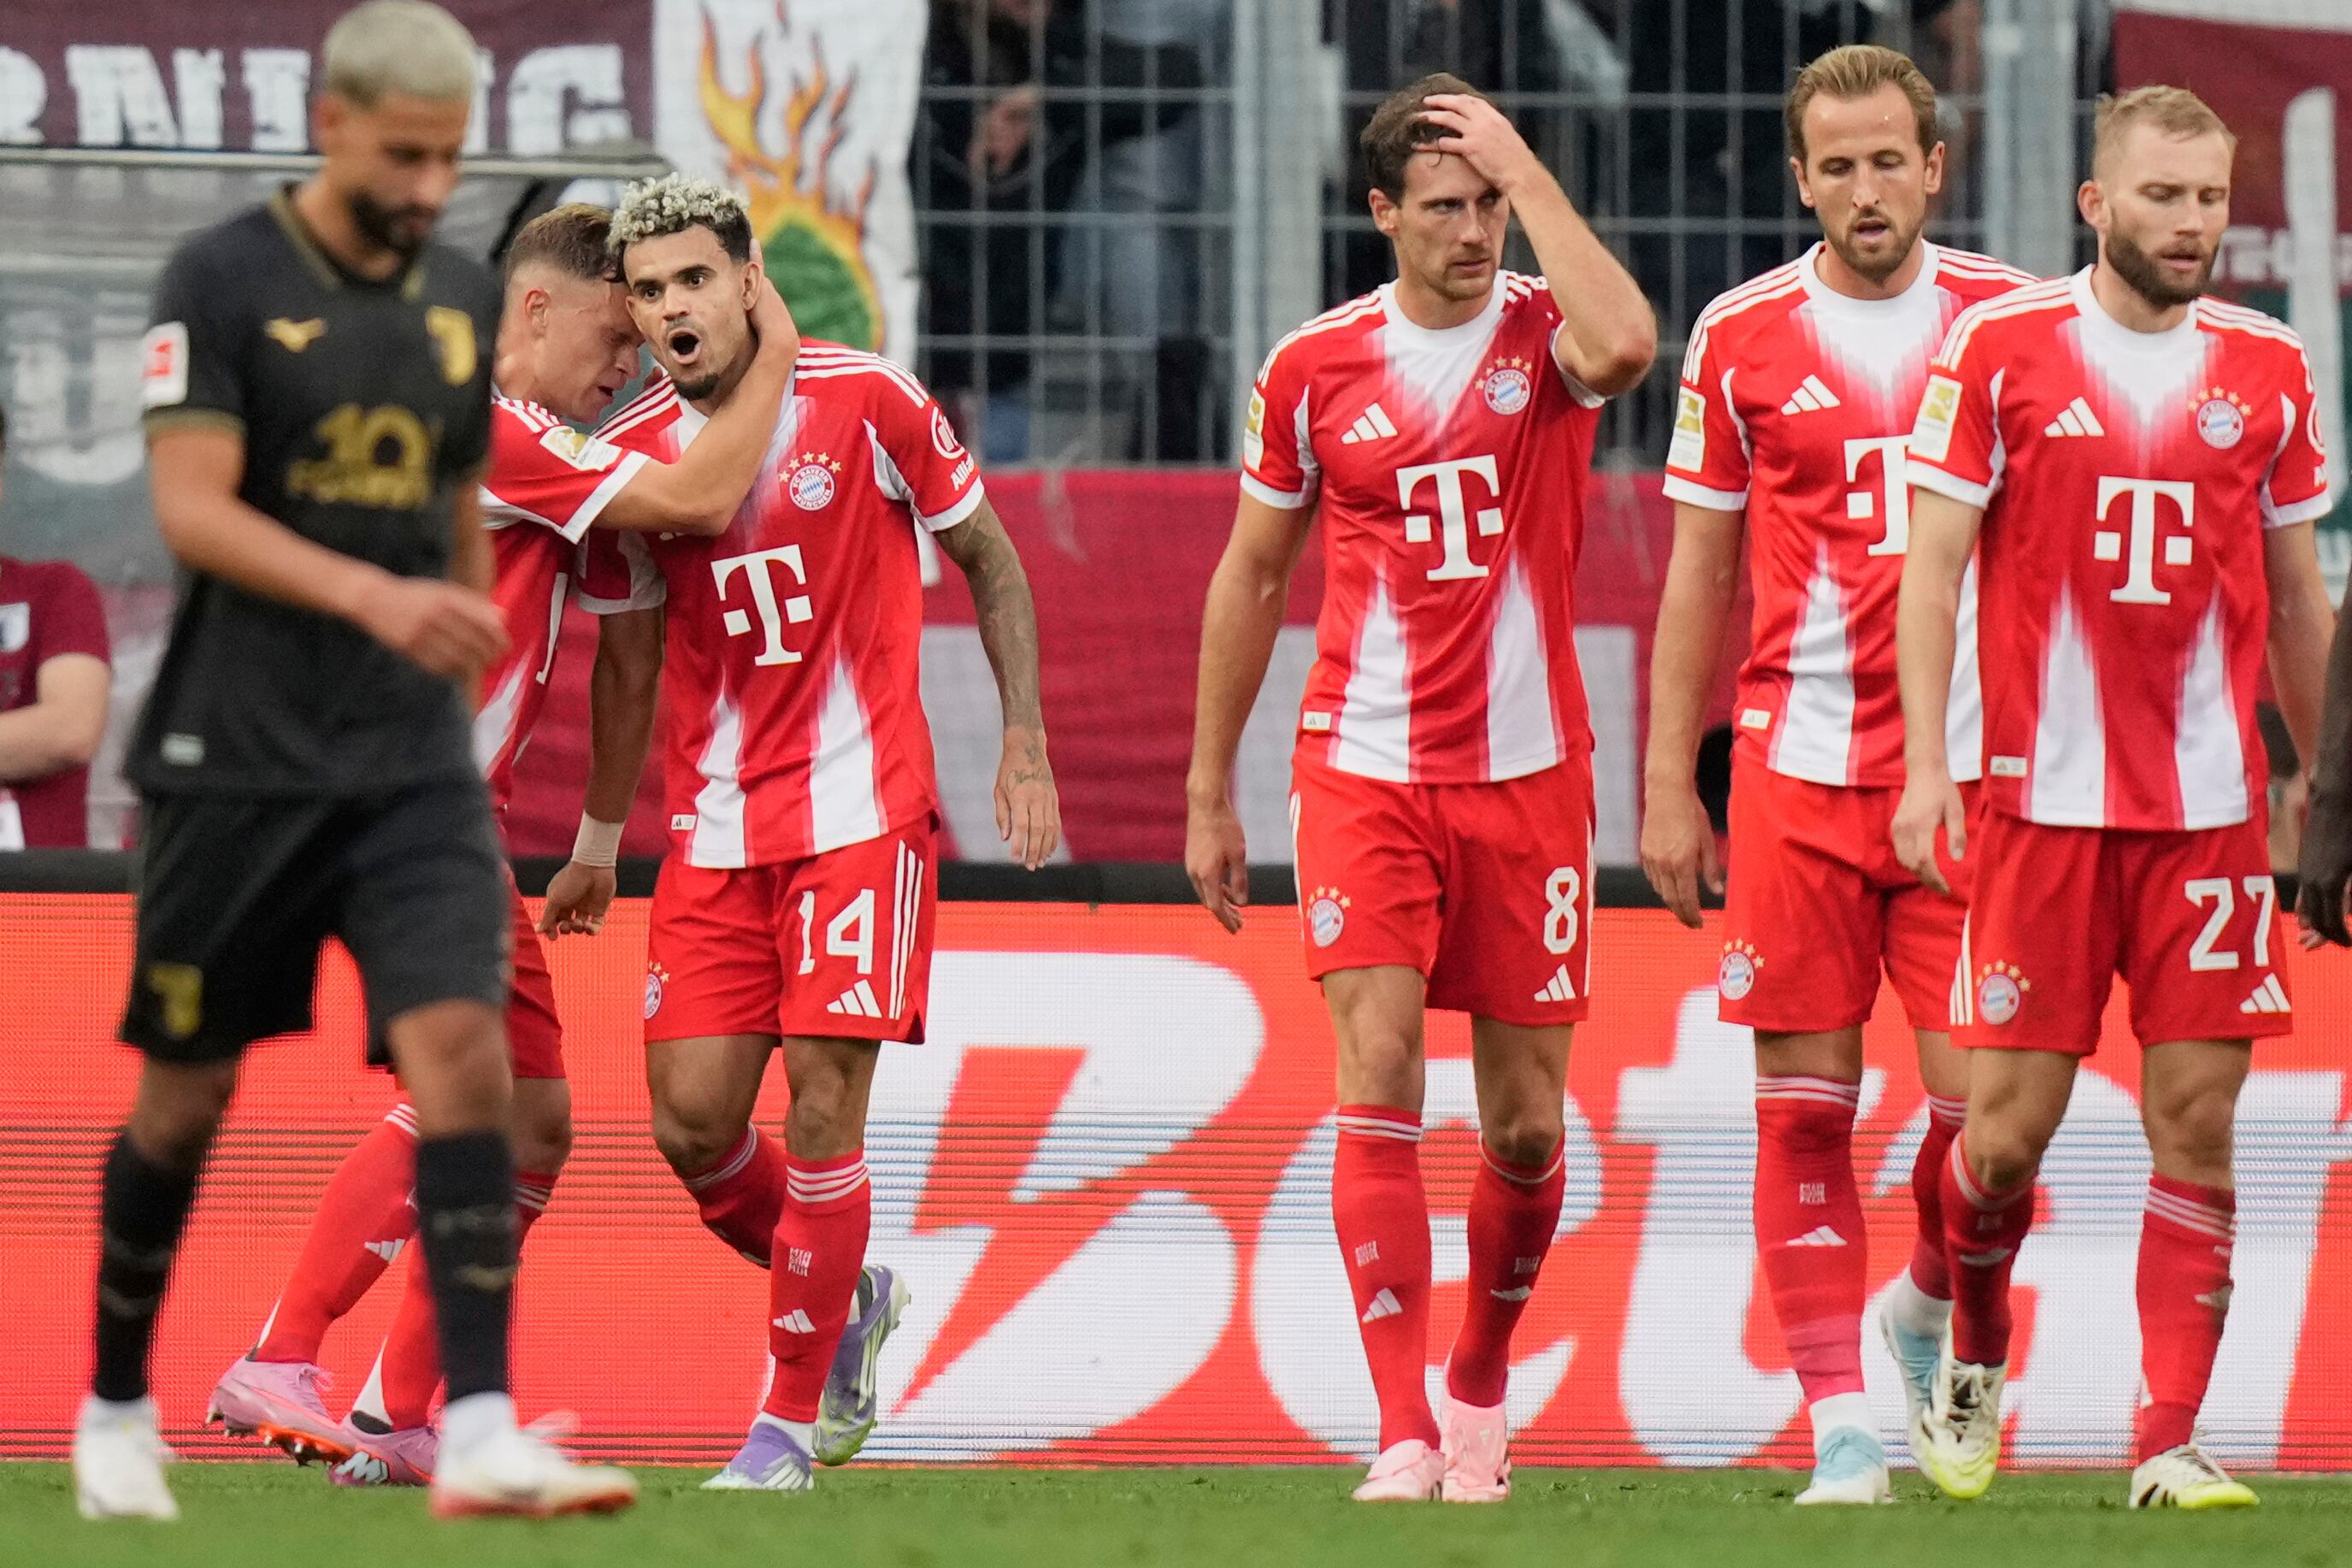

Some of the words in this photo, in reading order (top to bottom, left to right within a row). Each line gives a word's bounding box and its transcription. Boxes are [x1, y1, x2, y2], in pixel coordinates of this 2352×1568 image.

[1395, 454, 1504, 581] T
[2094, 475, 2195, 605] T
[710, 544, 814, 667] T
[797, 888, 875, 975] 14
[1543, 865, 1580, 955] 8
[2184, 875, 2275, 971] 27
